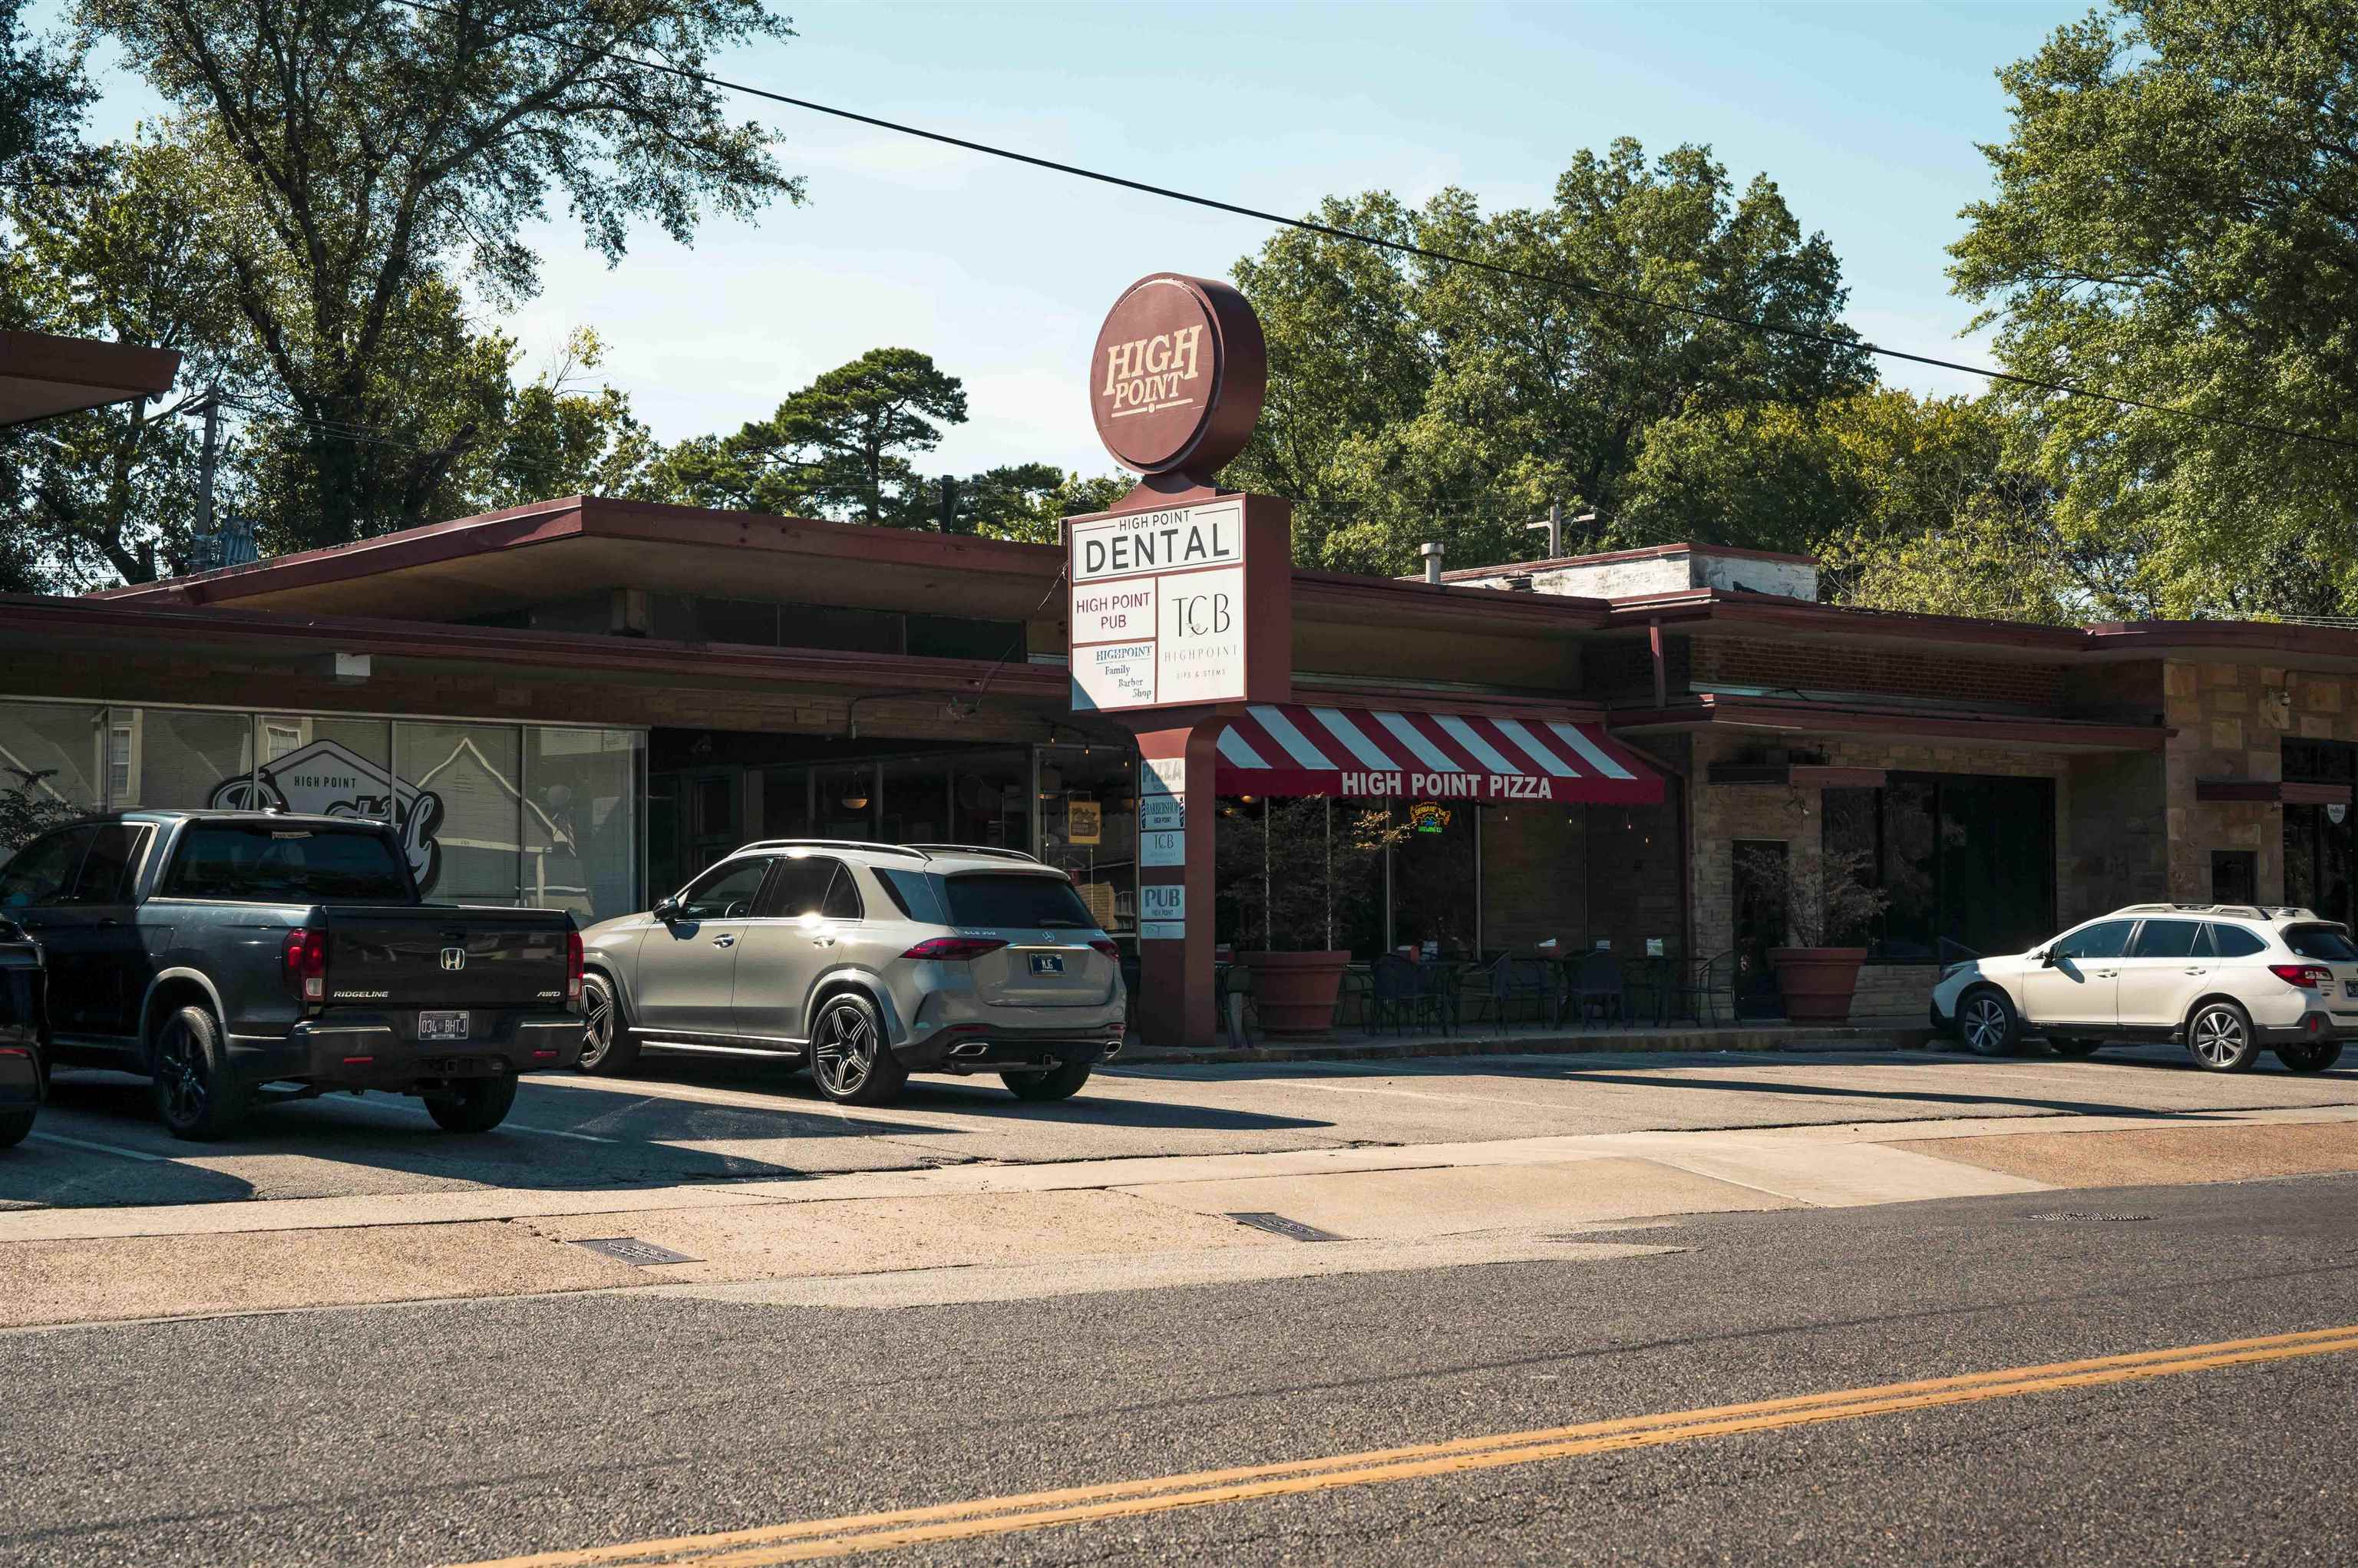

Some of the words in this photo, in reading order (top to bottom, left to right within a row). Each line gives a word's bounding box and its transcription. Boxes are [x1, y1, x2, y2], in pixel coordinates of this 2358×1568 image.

[1102, 324, 1203, 396] HIGH
[1112, 370, 1186, 410] POINT
[1119, 516, 1148, 531] HIGH
[1153, 510, 1190, 527] POINT
[1085, 523, 1230, 573] DENTAL
[1076, 597, 1108, 614] HIGH
[1112, 592, 1151, 611] POINT
[1100, 614, 1127, 630] PUB
[1172, 593, 1230, 637] TCB
[1096, 645, 1152, 662] HIGHPOINT
[1105, 664, 1131, 676] Family
[1118, 678, 1144, 688] Barber
[1132, 688, 1151, 699] Shop
[294, 775, 319, 787] HIGH
[323, 776, 357, 789] POINT
[1342, 772, 1402, 795] HIGH
[1412, 774, 1481, 797] POINT
[1490, 775, 1553, 799] PIZZA
[1154, 834, 1174, 849] TCB
[1144, 888, 1181, 907] PUB
[422, 1019, 437, 1033] 034
[445, 1019, 466, 1033] BHTJ
